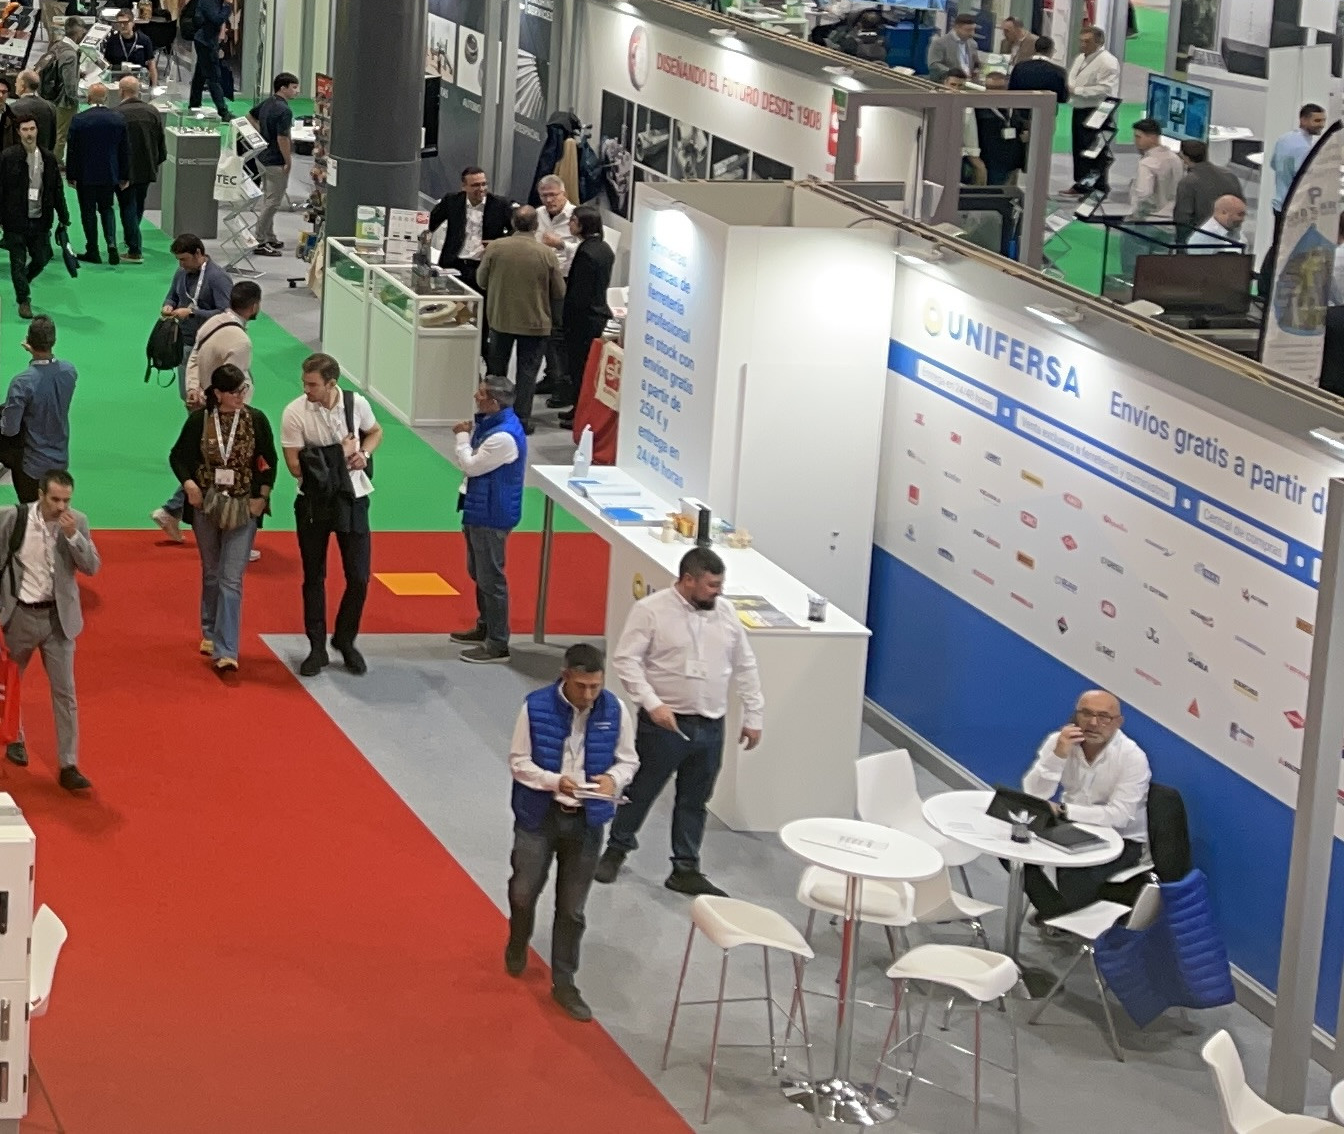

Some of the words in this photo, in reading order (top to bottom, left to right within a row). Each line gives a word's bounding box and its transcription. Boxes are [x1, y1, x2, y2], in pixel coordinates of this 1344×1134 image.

[656, 52, 709, 88] DISEÑANDO
[708, 71, 720, 93] EL
[761, 91, 796, 121] DESDE
[947, 310, 1081, 399] UNIFERSA
[1110, 390, 1170, 441] Envíos
[1174, 426, 1228, 468] gratis
[1233, 454, 1245, 478] a
[1250, 463, 1307, 506] partir
[1312, 486, 1327, 516] d
